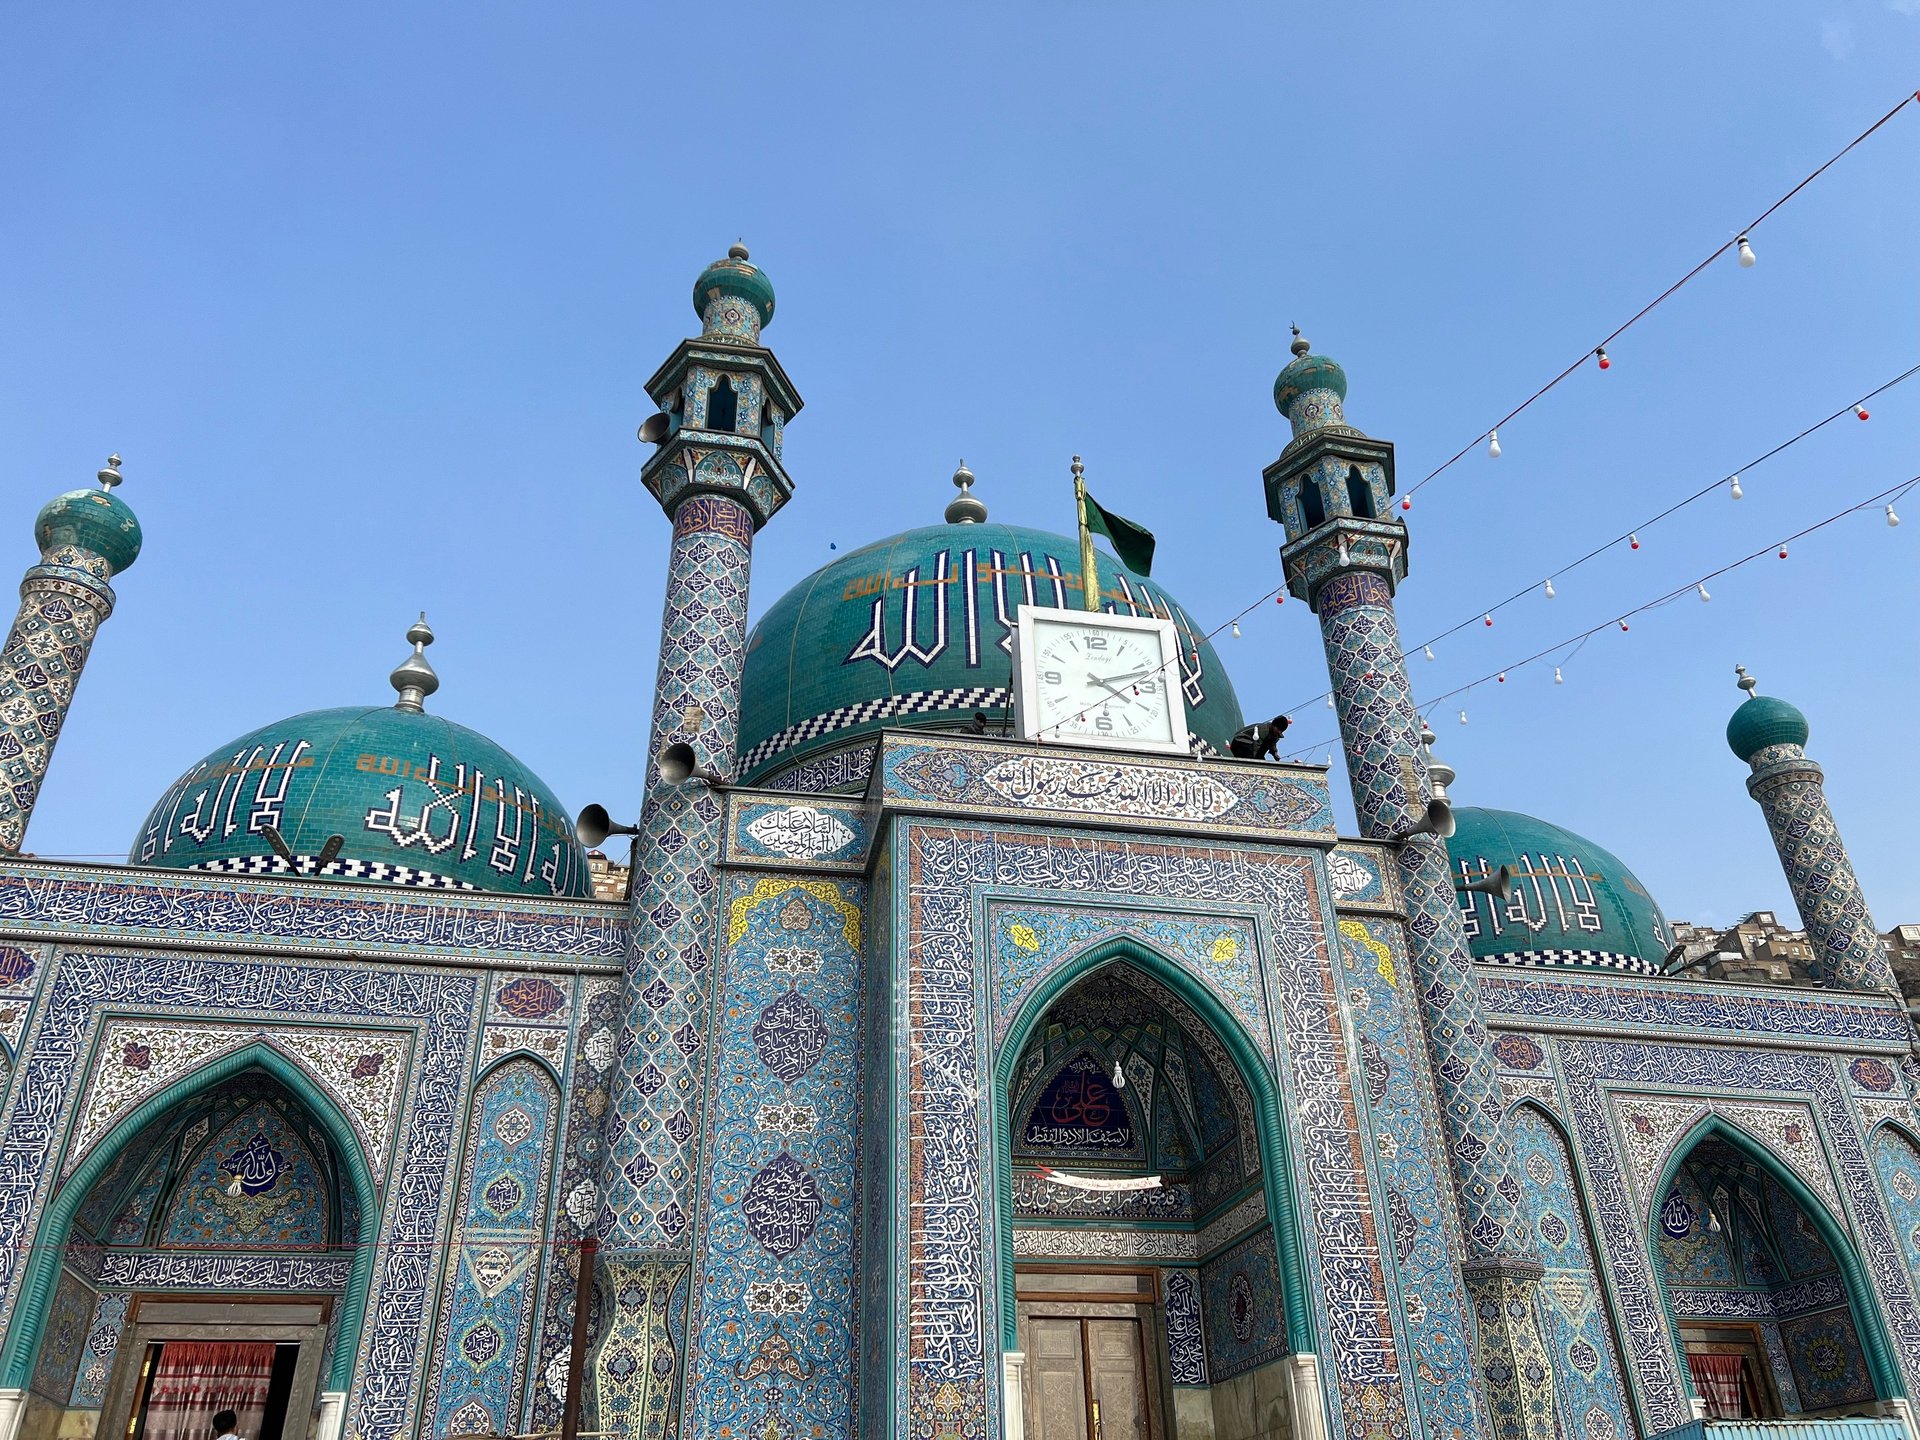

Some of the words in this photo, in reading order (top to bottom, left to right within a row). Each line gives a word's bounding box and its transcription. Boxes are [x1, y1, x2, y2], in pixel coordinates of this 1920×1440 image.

[1083, 636, 1108, 651] 12
[1044, 671, 1062, 685] 9
[1139, 680, 1157, 694] 3
[1095, 716, 1113, 731] 6
[1010, 763, 1060, 799] رسول
[1063, 770, 1123, 799] محمد
[1116, 779, 1148, 805] الله
[1052, 1071, 1110, 1127] علي
[236, 1150, 276, 1187] الله
[1664, 1200, 1690, 1234] الله
